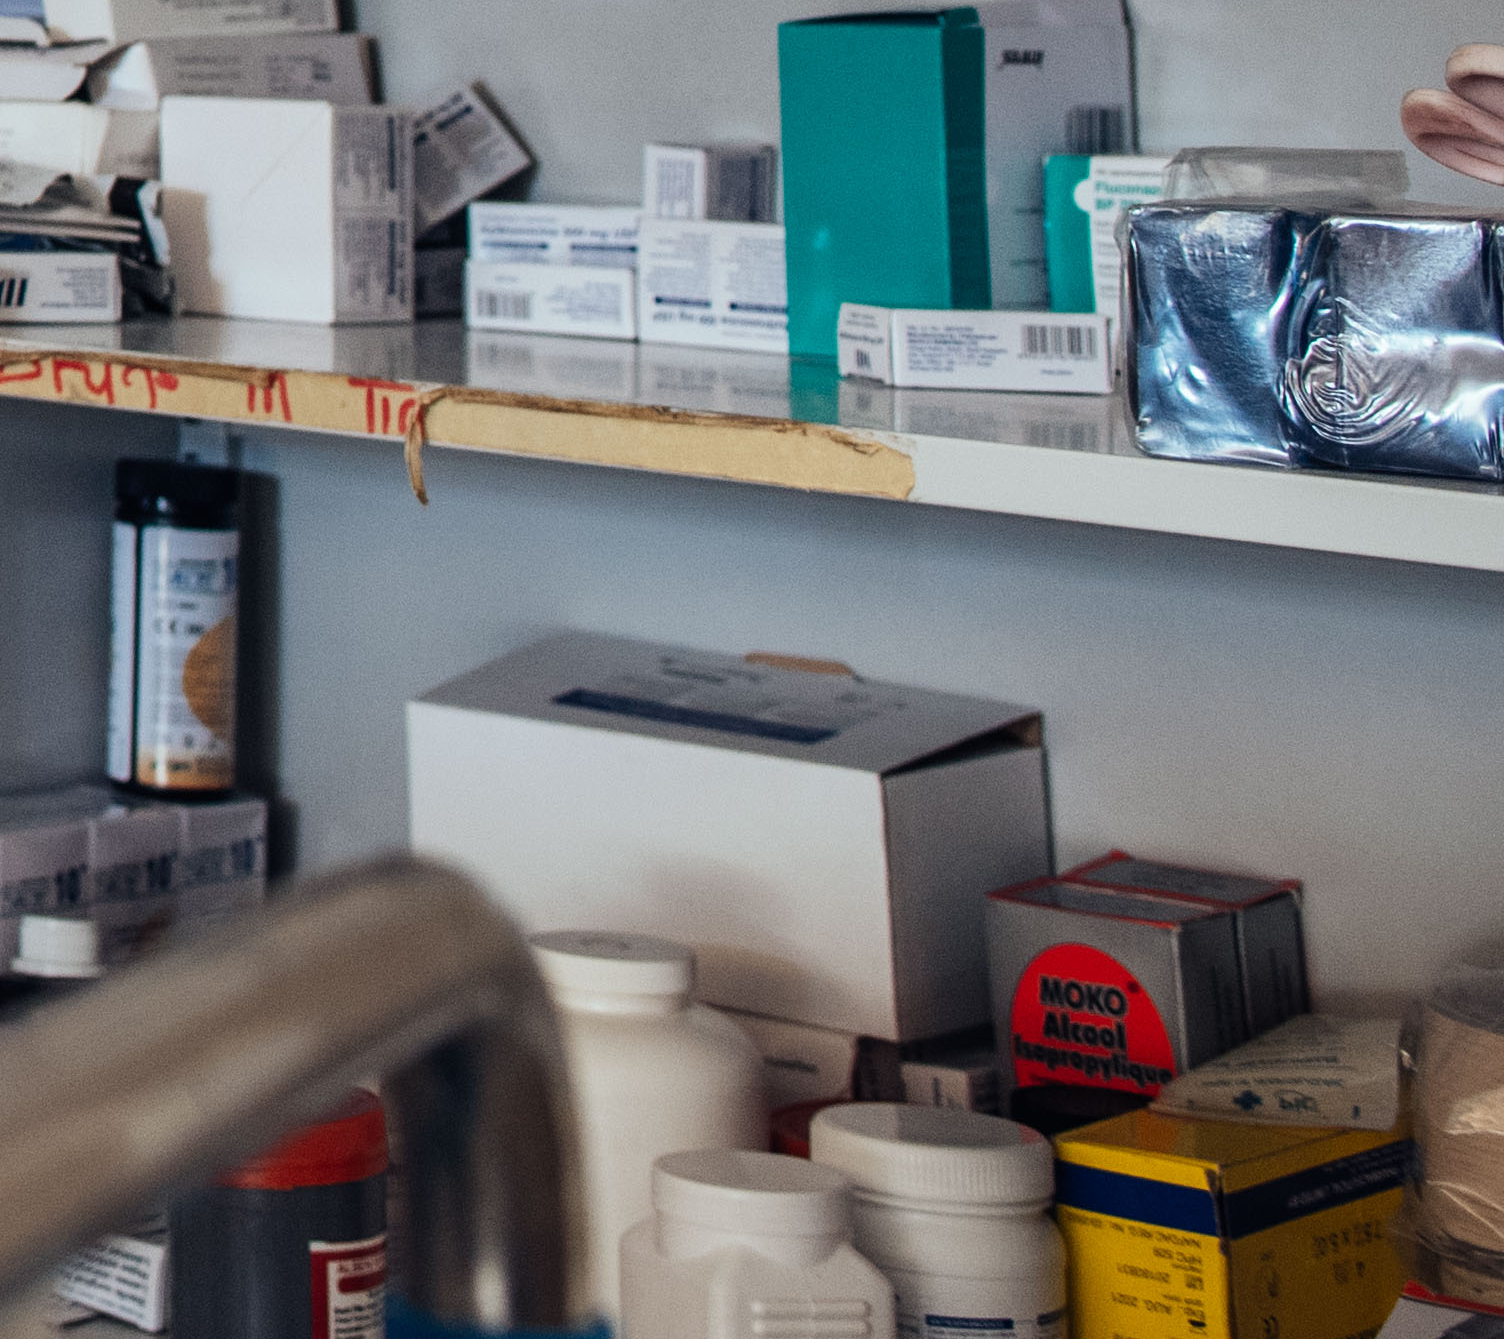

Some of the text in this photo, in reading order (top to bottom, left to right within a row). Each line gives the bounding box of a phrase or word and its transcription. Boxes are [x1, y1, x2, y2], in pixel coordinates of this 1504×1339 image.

[1039, 974, 1128, 1017] MOKO
[1043, 1010, 1127, 1052] Alcool
[1013, 1031, 1174, 1089] Isopropylique
